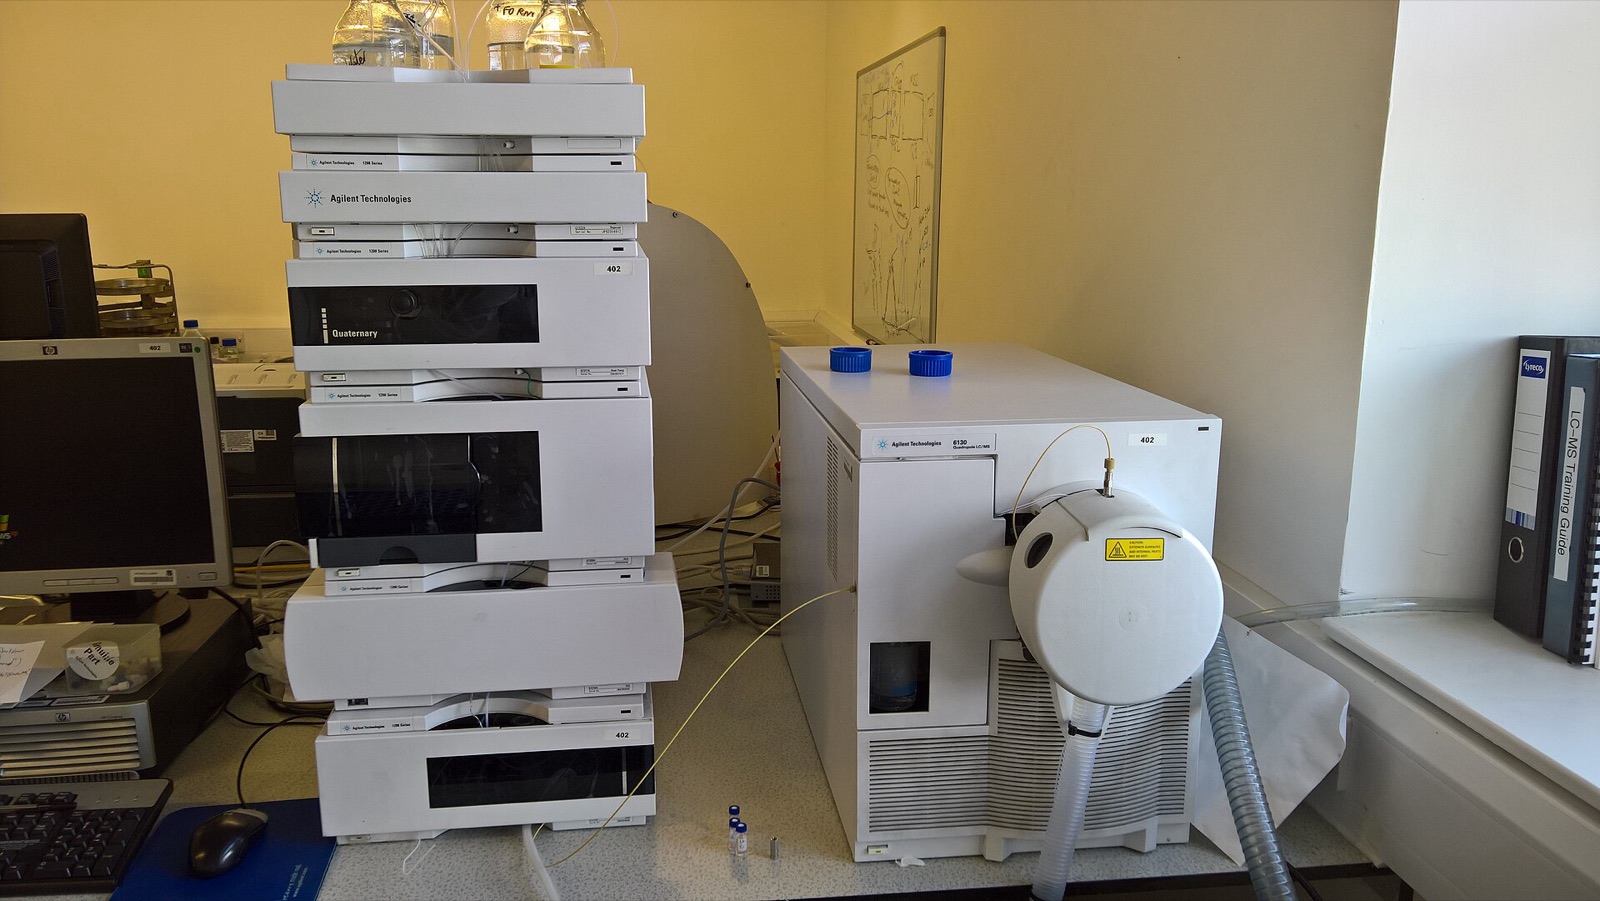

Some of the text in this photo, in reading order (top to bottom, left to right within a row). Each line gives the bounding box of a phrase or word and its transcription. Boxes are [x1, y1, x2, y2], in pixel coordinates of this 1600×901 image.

[330, 194, 412, 204] Agilent Technologies
[606, 265, 621, 273] 402
[332, 329, 378, 339] Quaternary
[910, 440, 942, 448] Technologies
[1140, 436, 1155, 444] 402
[1557, 410, 1581, 556] LC-MS Training Guide
[84, 647, 100, 665] Part
